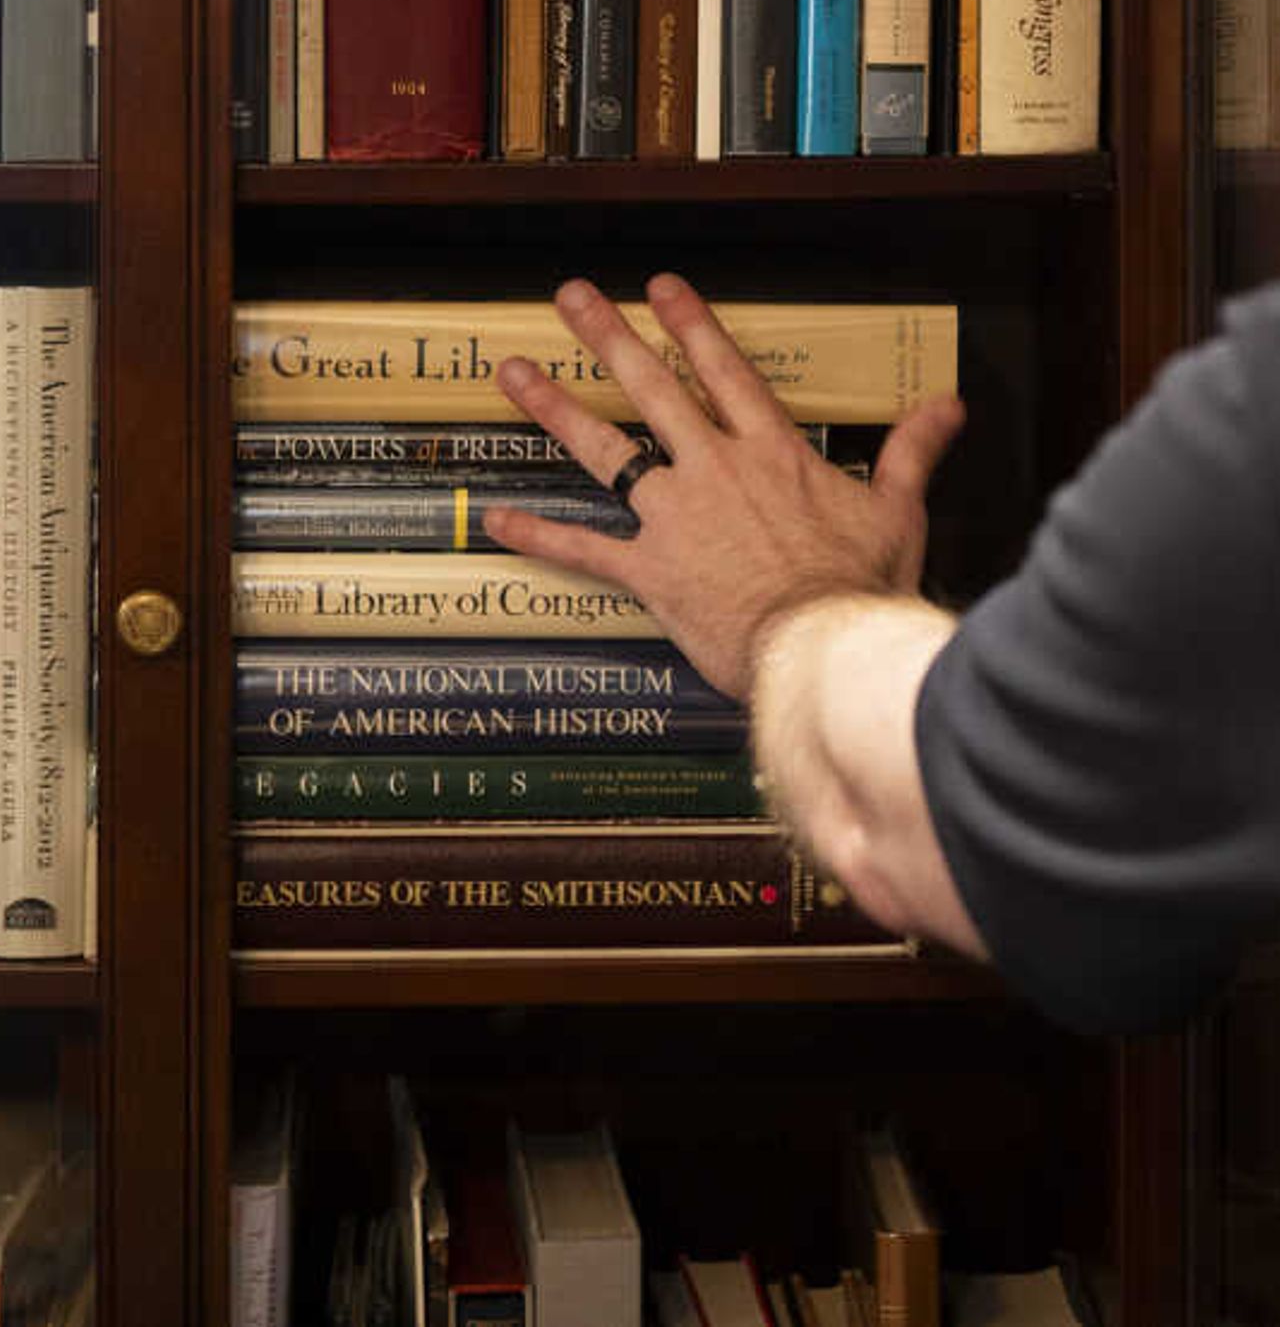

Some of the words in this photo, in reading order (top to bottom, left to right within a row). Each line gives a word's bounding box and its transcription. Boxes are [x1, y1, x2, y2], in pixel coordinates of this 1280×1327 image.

[4, 321, 19, 332] A
[39, 319, 72, 369] The
[269, 335, 393, 383] Great
[411, 337, 614, 384] Librie
[39, 379, 70, 495] American
[273, 435, 406, 463] POWERS
[415, 435, 442, 463] of
[3, 531, 19, 634] HISTORY
[32, 504, 68, 652] Antiquarian
[312, 581, 451, 623] Library
[454, 581, 498, 623] of
[499, 581, 648, 623] Congres
[1, 659, 18, 742] PHILIP
[35, 653, 67, 746] Society,
[274, 667, 336, 695] THE
[351, 667, 518, 695] NATIONAL
[525, 667, 673, 695] MUSEUM
[268, 707, 313, 737] OF
[330, 707, 515, 737] AMERICAN
[533, 707, 672, 737] HISTORY
[256, 770, 528, 797] EGACIES
[0, 780, 16, 844] GURA
[236, 879, 382, 908] EASURES
[390, 879, 432, 908] OF
[443, 879, 511, 908] THE
[522, 879, 755, 908] SMITHSONIAN
